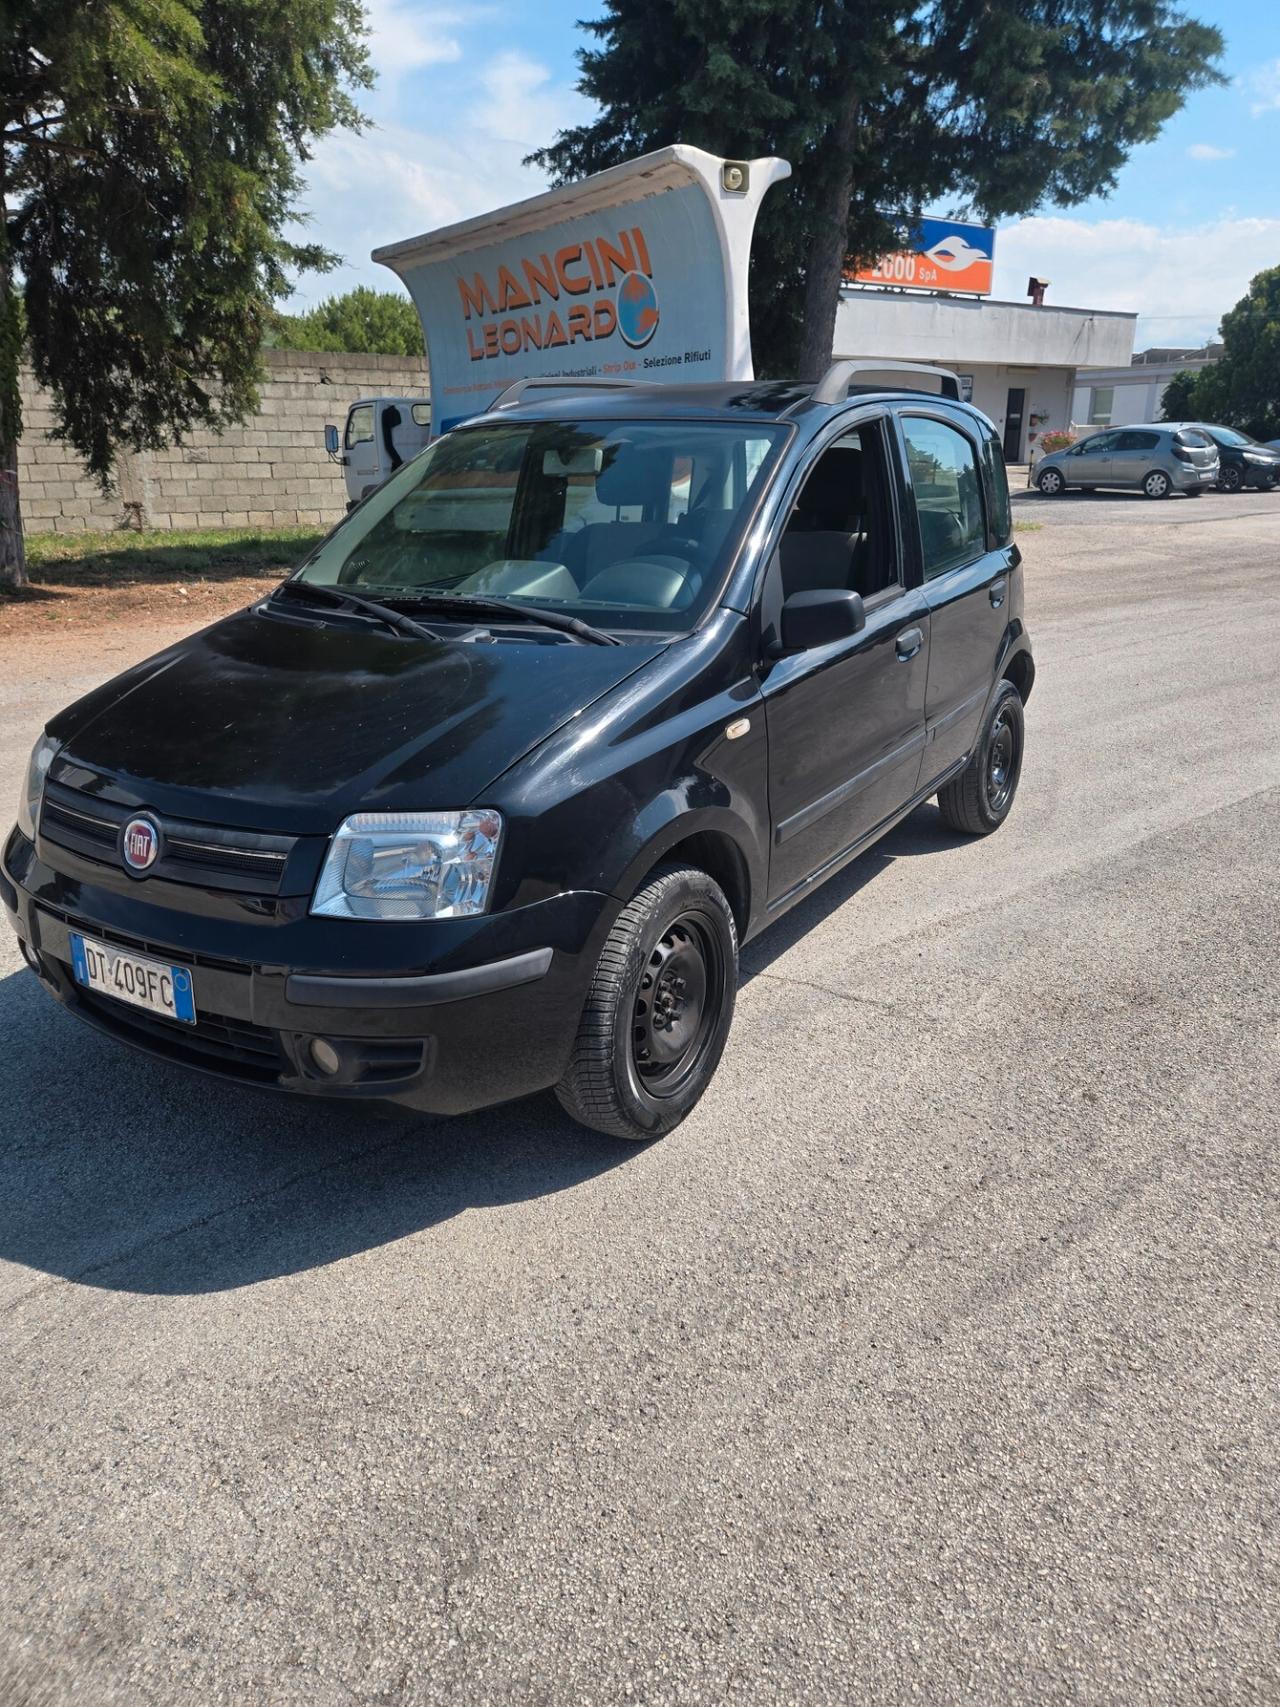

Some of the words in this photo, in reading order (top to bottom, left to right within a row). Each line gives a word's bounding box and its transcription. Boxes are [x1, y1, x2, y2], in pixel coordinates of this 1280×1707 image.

[457, 226, 653, 320] MANCINI
[919, 267, 937, 282] SpA
[643, 354, 682, 369] Selezione
[684, 350, 711, 363] Rifiuti
[130, 833, 150, 857] FIAT
